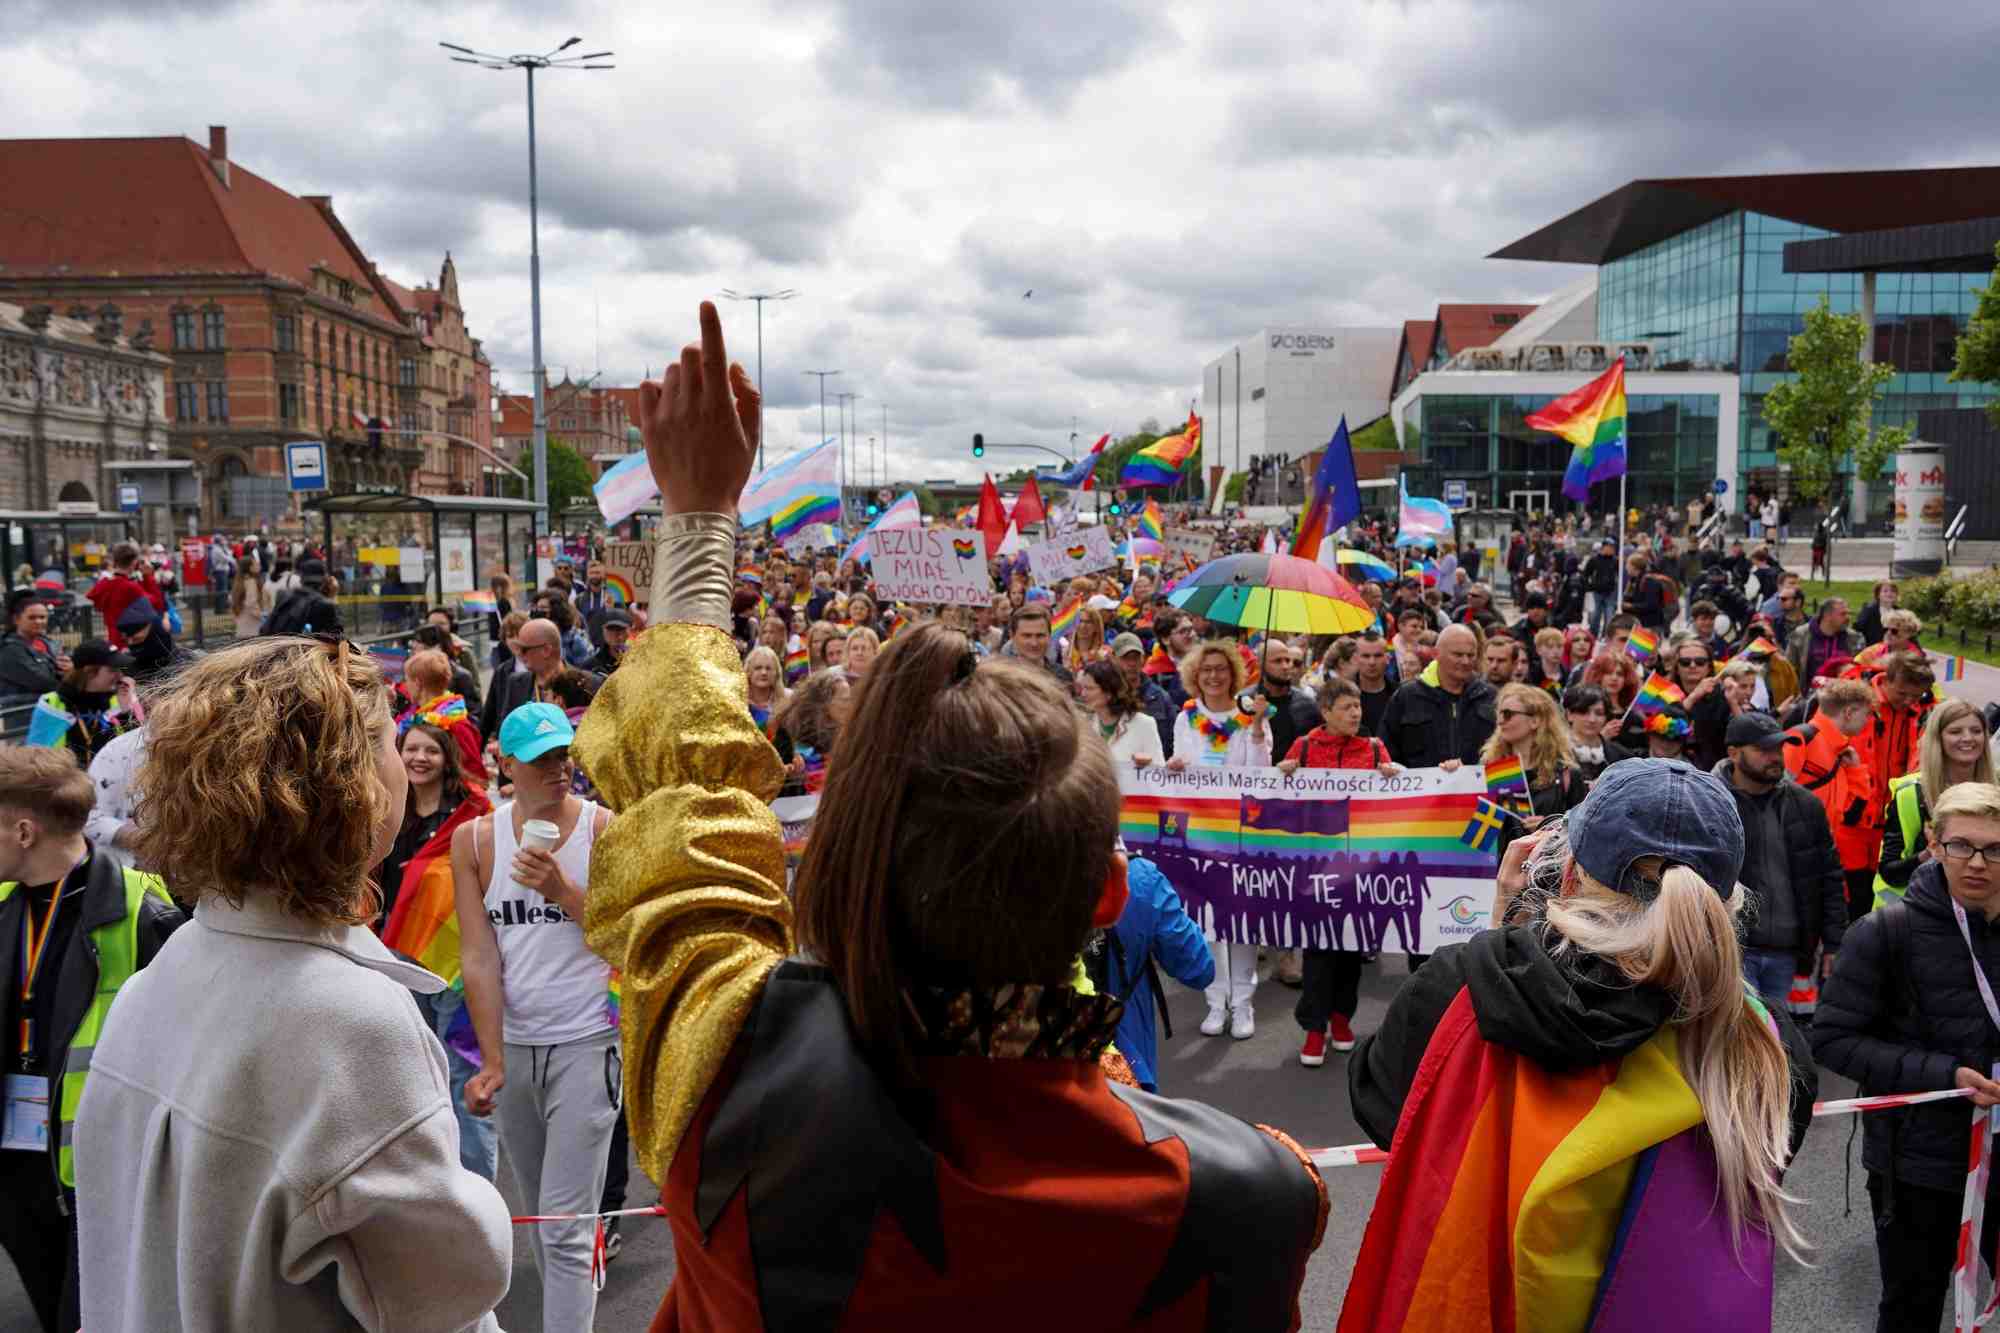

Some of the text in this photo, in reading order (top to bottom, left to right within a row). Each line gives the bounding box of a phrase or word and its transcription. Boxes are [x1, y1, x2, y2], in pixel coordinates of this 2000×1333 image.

[870, 530, 944, 558] JEZUS
[1136, 768, 1423, 792] Trójmiejski Marsz Równości 2022
[1232, 864, 1415, 908] MAMY TĘ MOC!
